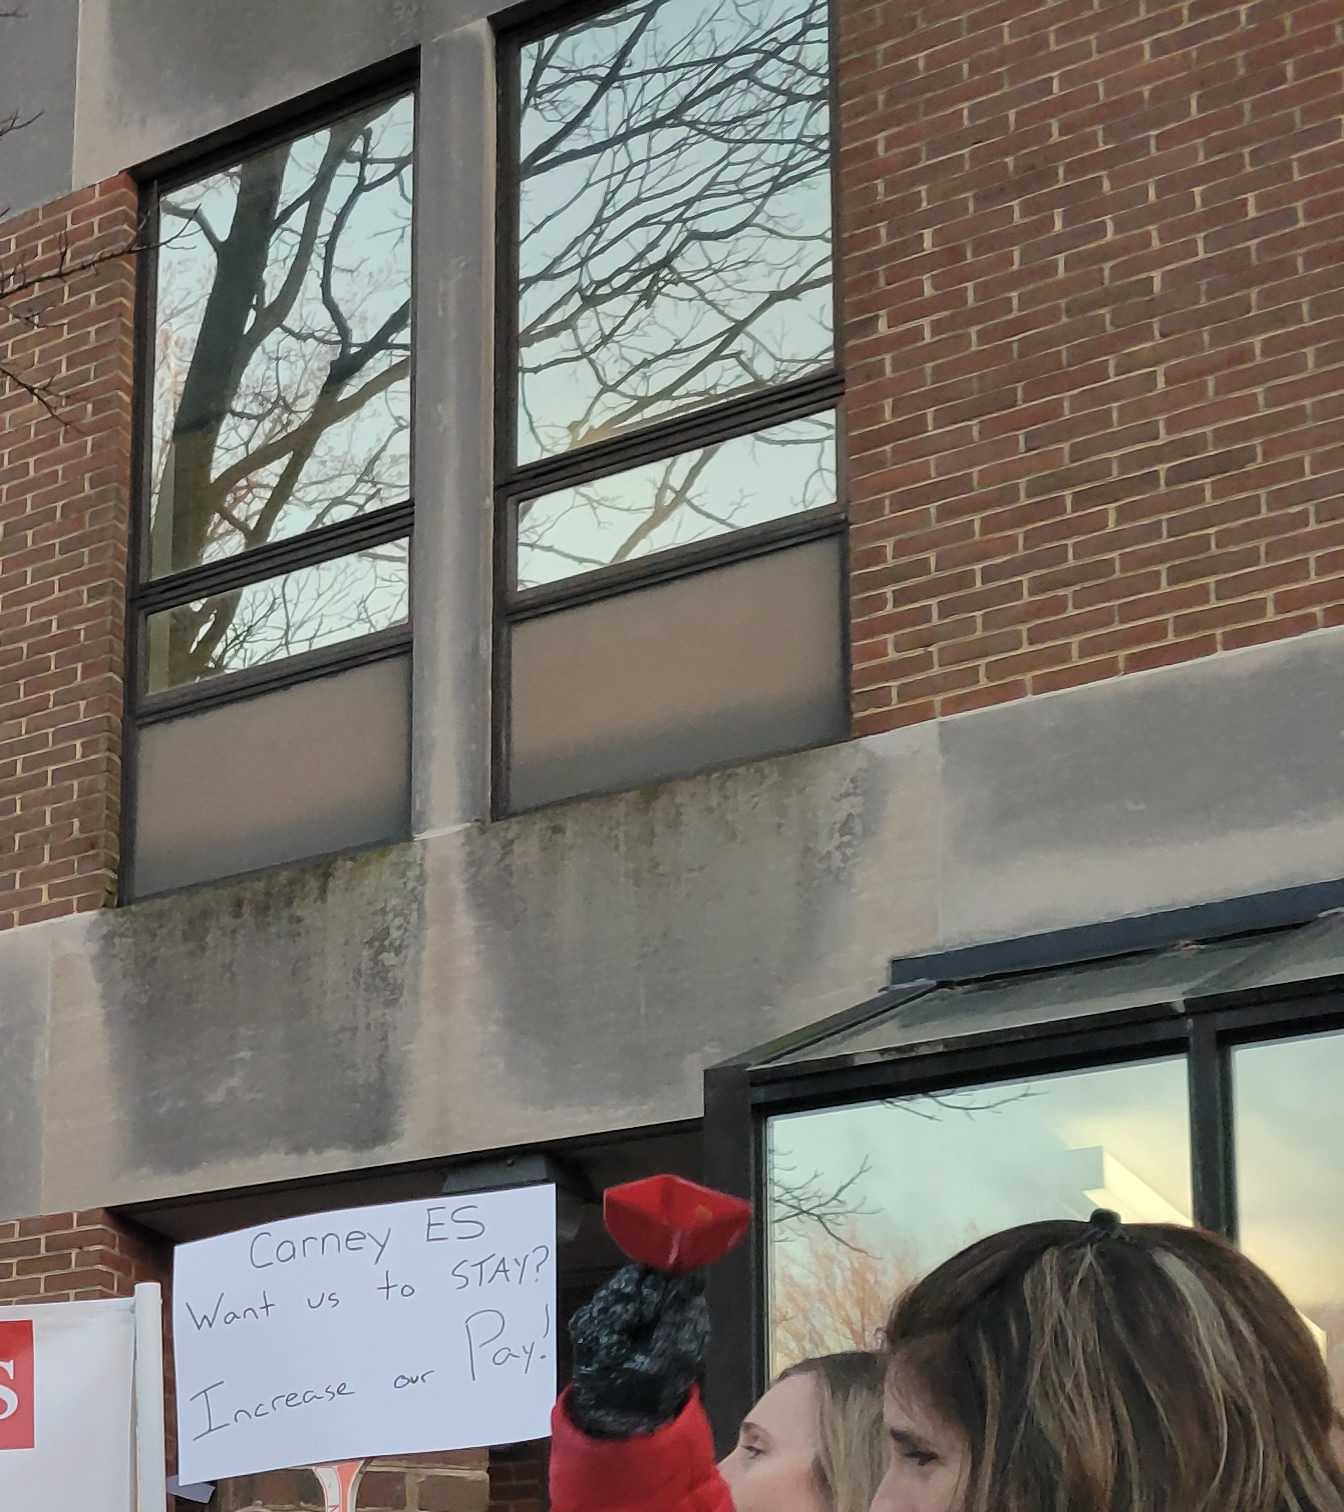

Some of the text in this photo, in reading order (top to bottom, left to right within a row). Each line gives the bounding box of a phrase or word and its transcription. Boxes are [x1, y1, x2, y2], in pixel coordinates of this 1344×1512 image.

[250, 1206, 485, 1268] Carney ES
[185, 1245, 550, 1332] Want us to STAY?
[190, 1380, 355, 1441] Increase
[394, 1370, 435, 1389] our
